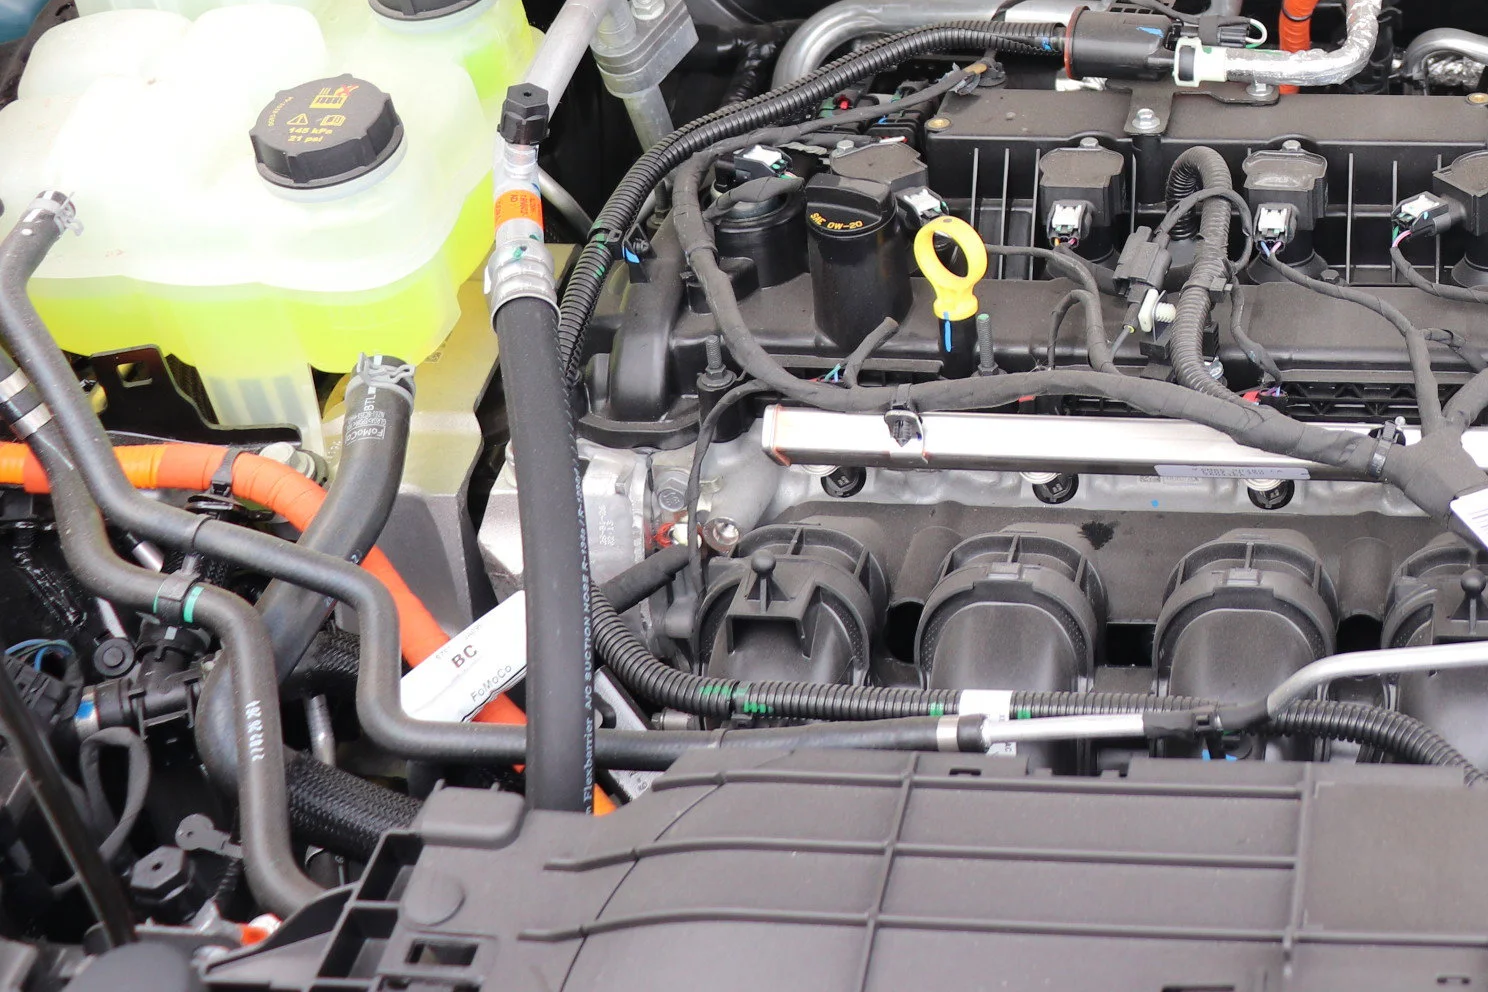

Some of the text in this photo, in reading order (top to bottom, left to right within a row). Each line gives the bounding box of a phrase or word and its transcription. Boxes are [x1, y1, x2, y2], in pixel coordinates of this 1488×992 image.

[304, 135, 324, 143] psi
[311, 127, 333, 135] kPa
[810, 212, 864, 230] SAE 0W-20
[364, 394, 377, 411] BTL
[346, 428, 385, 442] FoMoCo
[582, 574, 591, 613] HOSE
[452, 645, 477, 668] BC
[584, 616, 593, 682] SUCTION
[470, 665, 512, 702] FoMoCo
[585, 686, 593, 710] A/C
[584, 717, 593, 802] Flexbarrier
